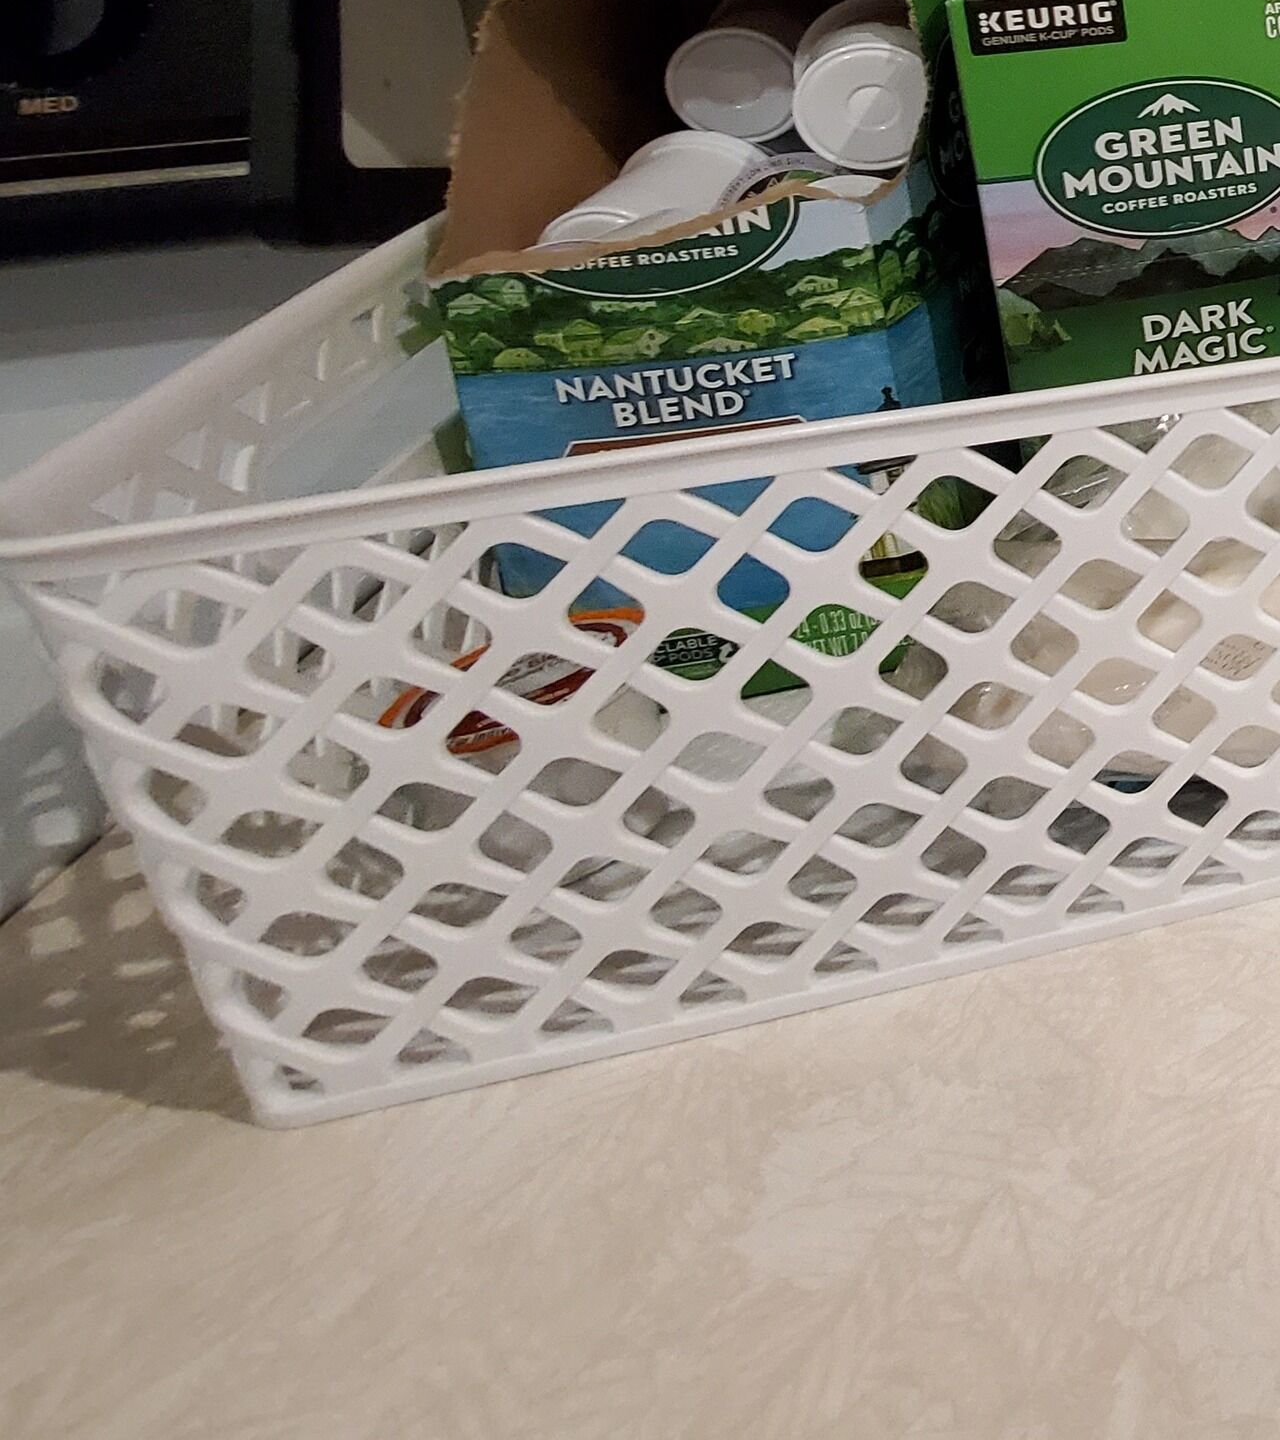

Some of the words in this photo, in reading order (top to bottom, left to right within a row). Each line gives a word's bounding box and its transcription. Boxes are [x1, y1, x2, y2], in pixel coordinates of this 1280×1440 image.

[982, 33, 1038, 47] GENUINE
[1081, 26, 1115, 37] PODS
[17, 96, 79, 116] MED
[1094, 116, 1245, 162] GREEN
[1102, 195, 1169, 215] COFFEE
[1173, 183, 1257, 206] ROASTERS
[637, 244, 739, 266] ROASTERS
[1141, 298, 1256, 343] DARK
[555, 353, 796, 404] NANTUCKET
[613, 390, 745, 428] BLEND
[819, 609, 847, 634] 0.33
[657, 635, 719, 655] CLABLE
[668, 648, 714, 663] PODS
